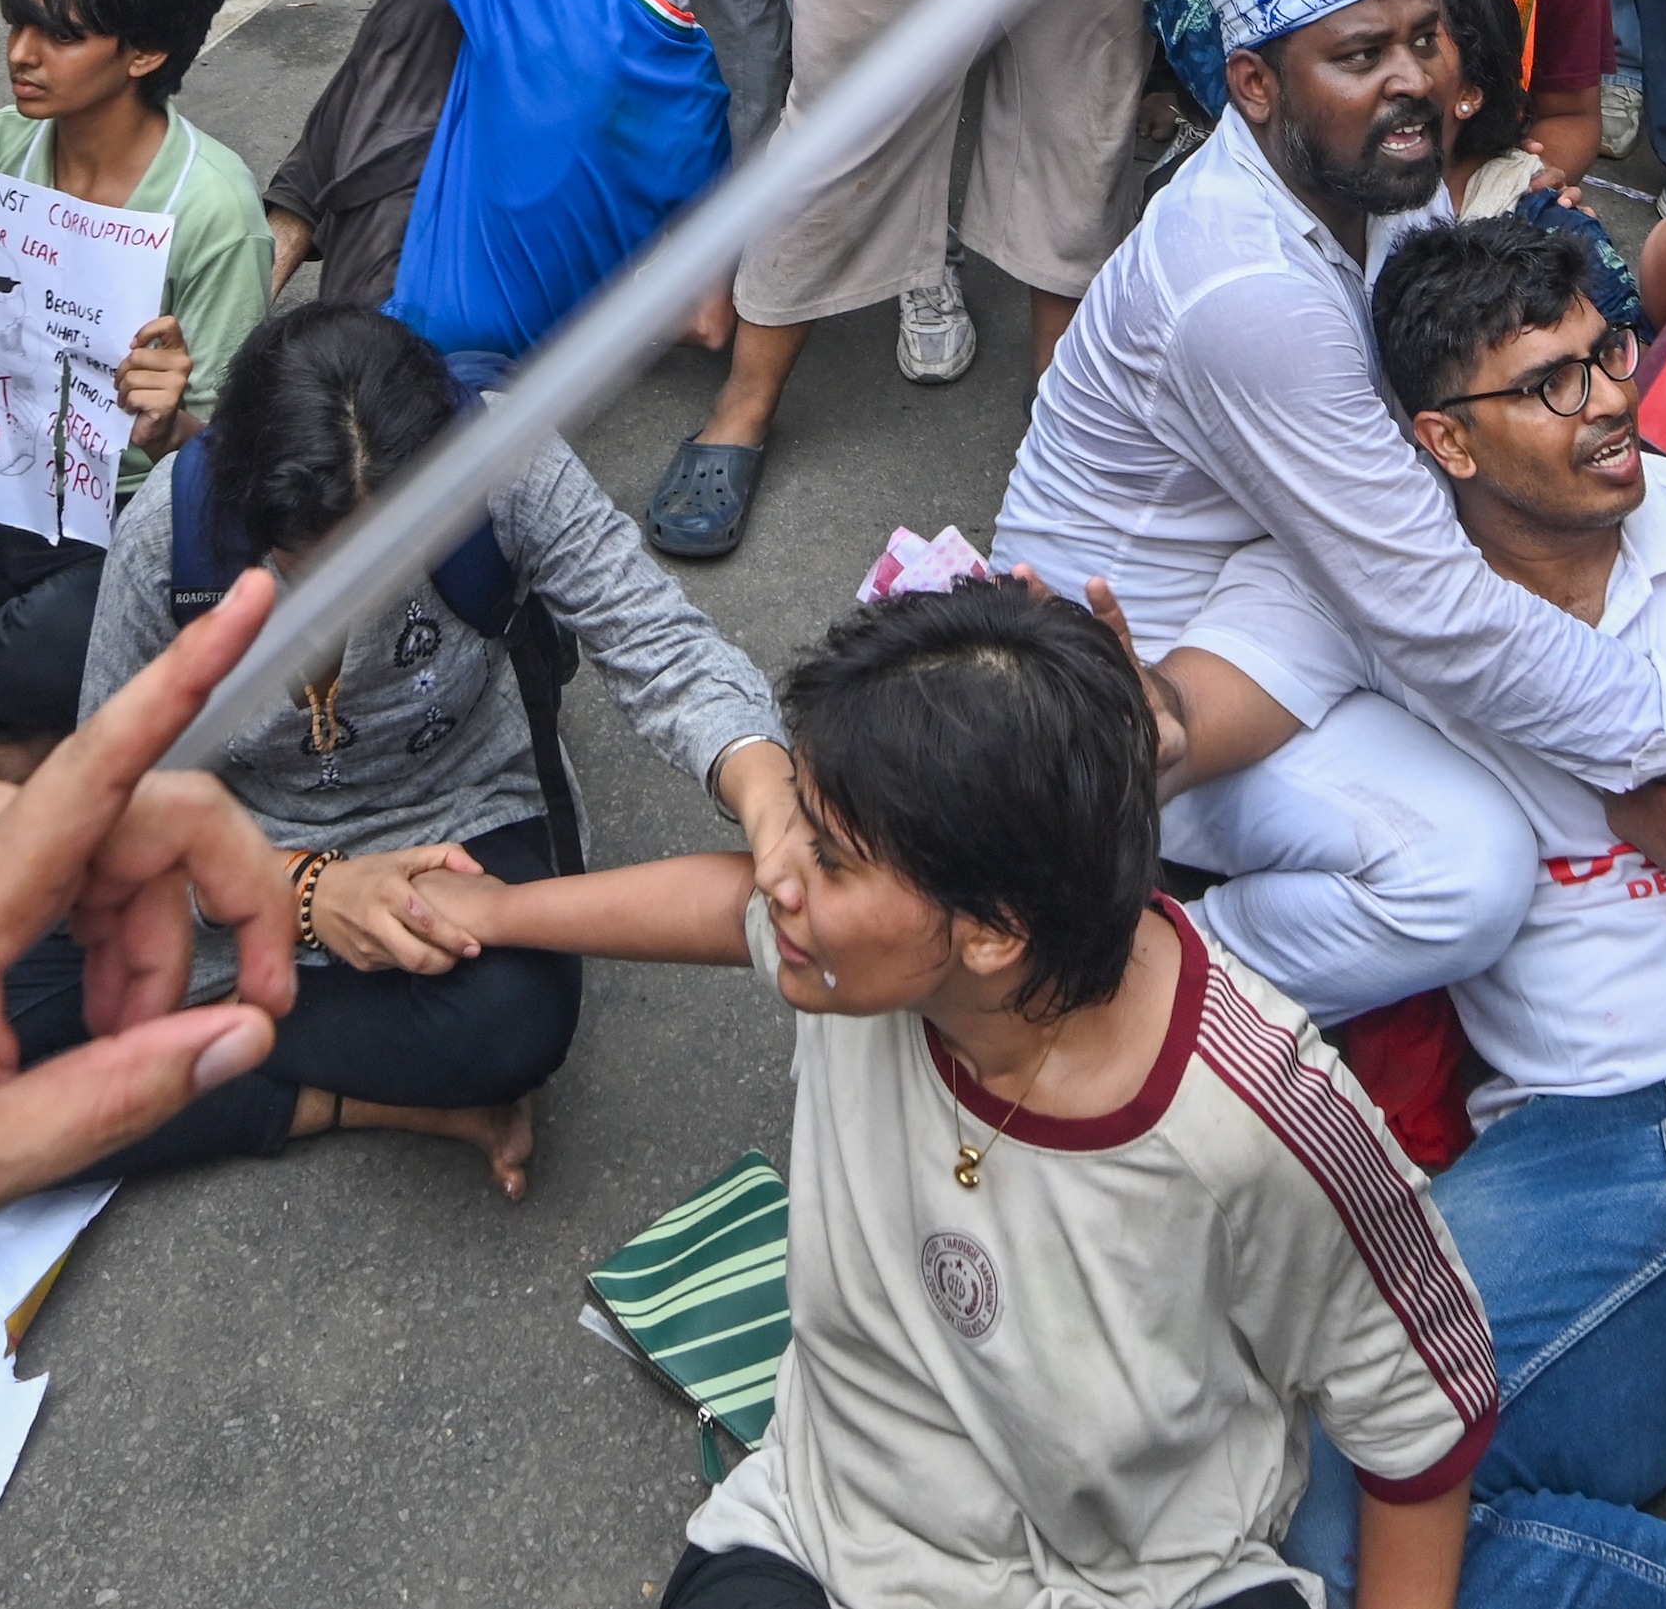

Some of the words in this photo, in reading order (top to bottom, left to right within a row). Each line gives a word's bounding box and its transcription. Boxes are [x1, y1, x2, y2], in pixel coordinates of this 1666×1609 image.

[49, 203, 170, 250] CORRUPTION
[21, 235, 58, 267] LEAK
[46, 289, 103, 325] BECAUSE
[175, 592, 224, 604] ROADSTE
[943, 1237, 981, 1262] THROUGH
